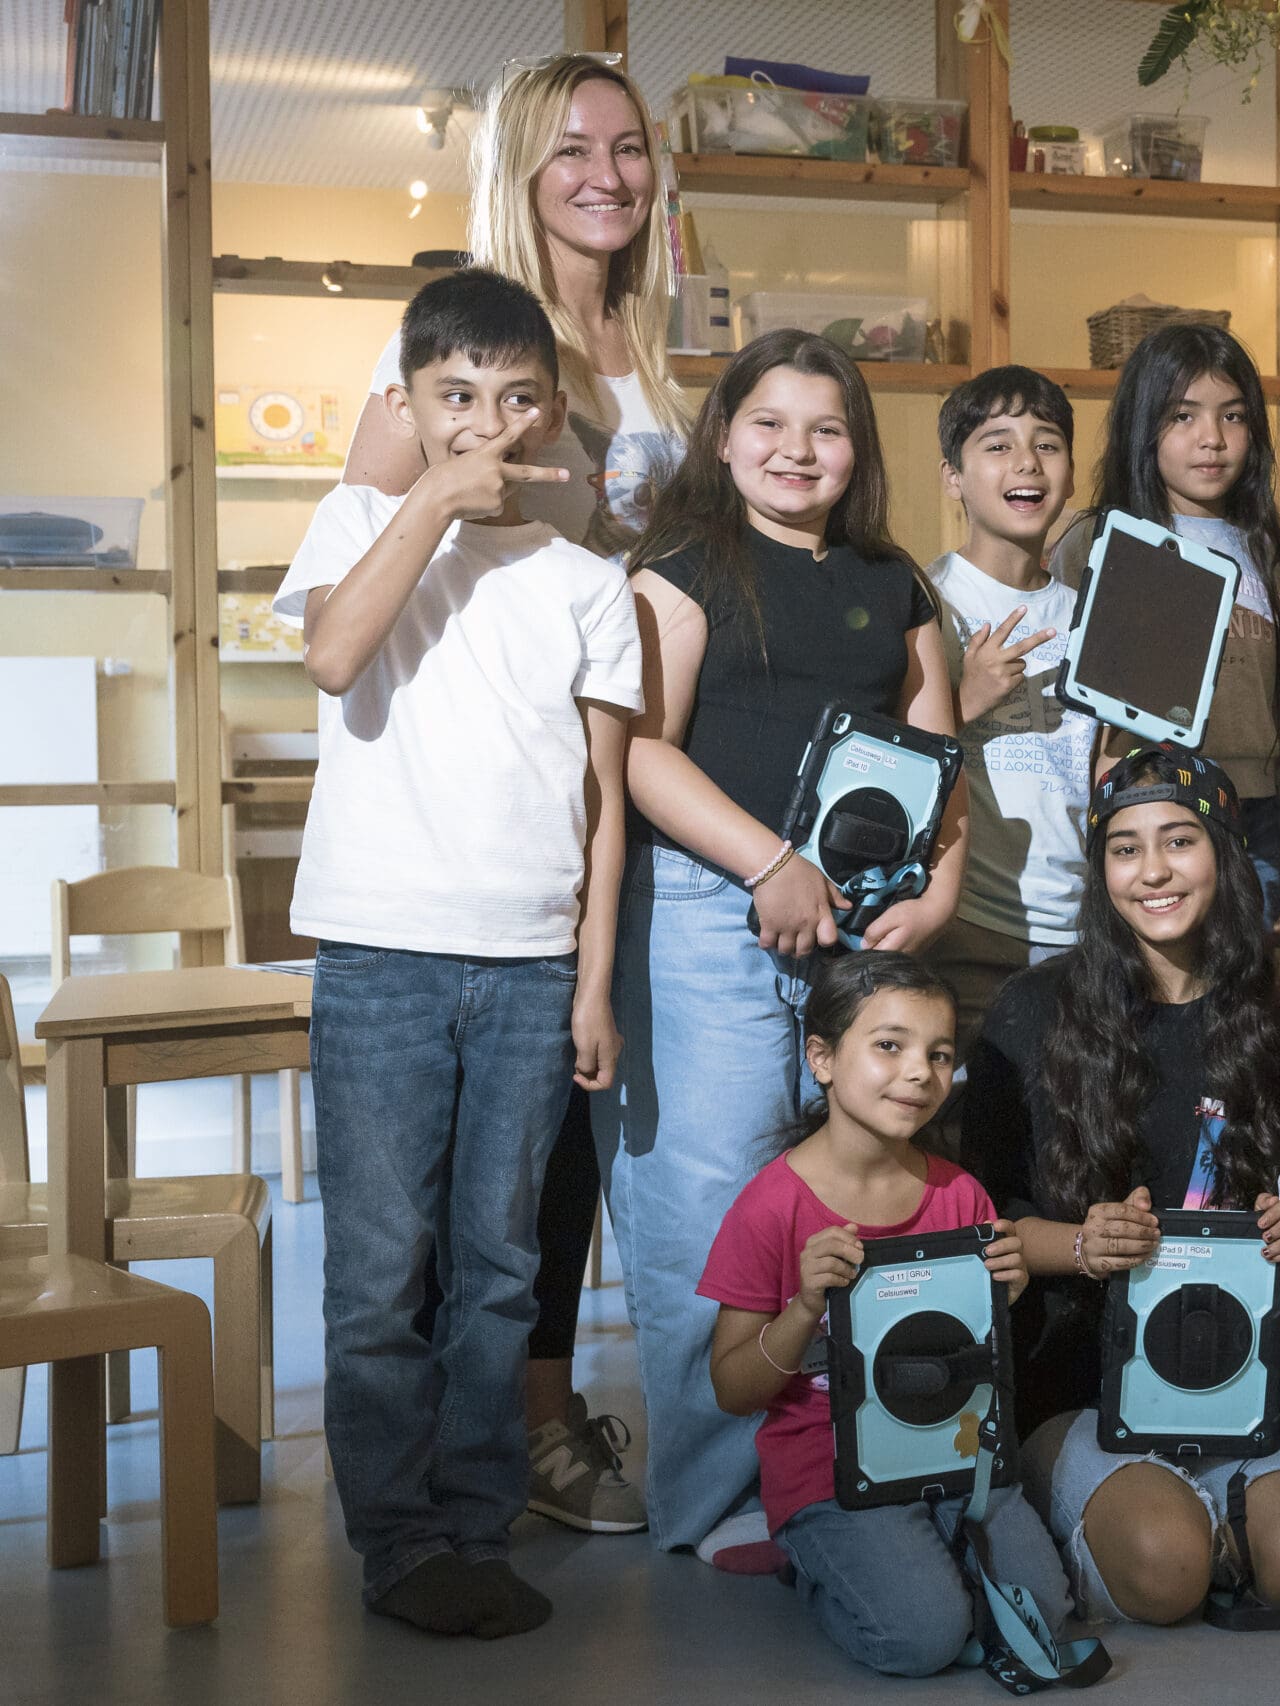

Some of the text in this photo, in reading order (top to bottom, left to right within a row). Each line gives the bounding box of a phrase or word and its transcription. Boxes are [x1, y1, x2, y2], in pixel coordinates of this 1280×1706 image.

[1190, 1246, 1211, 1255] ROSA
[1146, 1260, 1186, 1269] Celsiusweg
[878, 1288, 918, 1298] Celsiusweg
